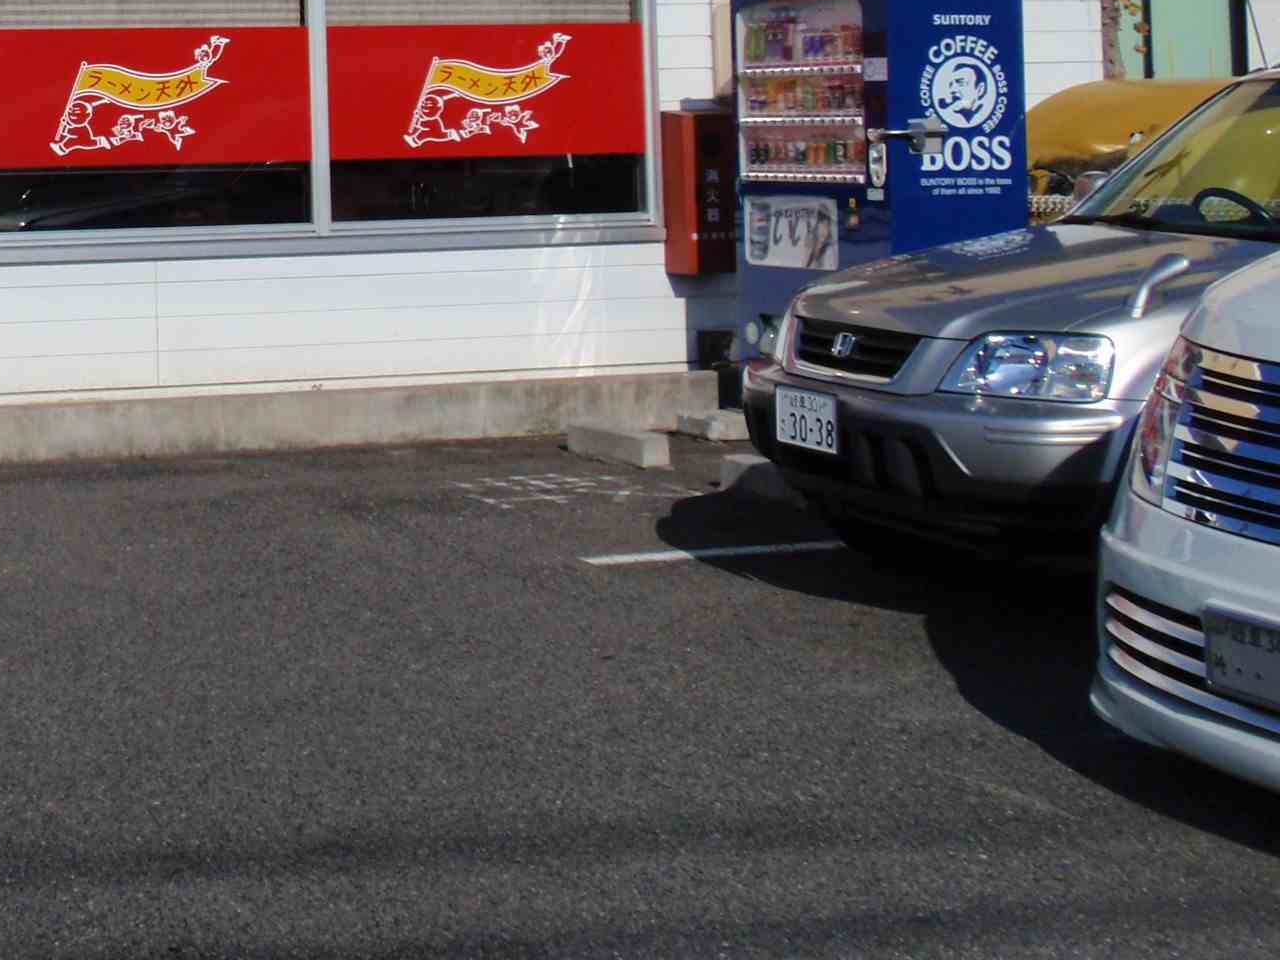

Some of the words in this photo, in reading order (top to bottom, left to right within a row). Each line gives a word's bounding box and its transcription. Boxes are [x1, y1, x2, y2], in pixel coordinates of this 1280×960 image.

[933, 14, 992, 26] SUNTORY
[928, 35, 998, 64] COFFEE
[88, 70, 198, 102] ラーメン天外
[439, 65, 542, 96] ラーメン天外
[920, 136, 1012, 171] BOSS
